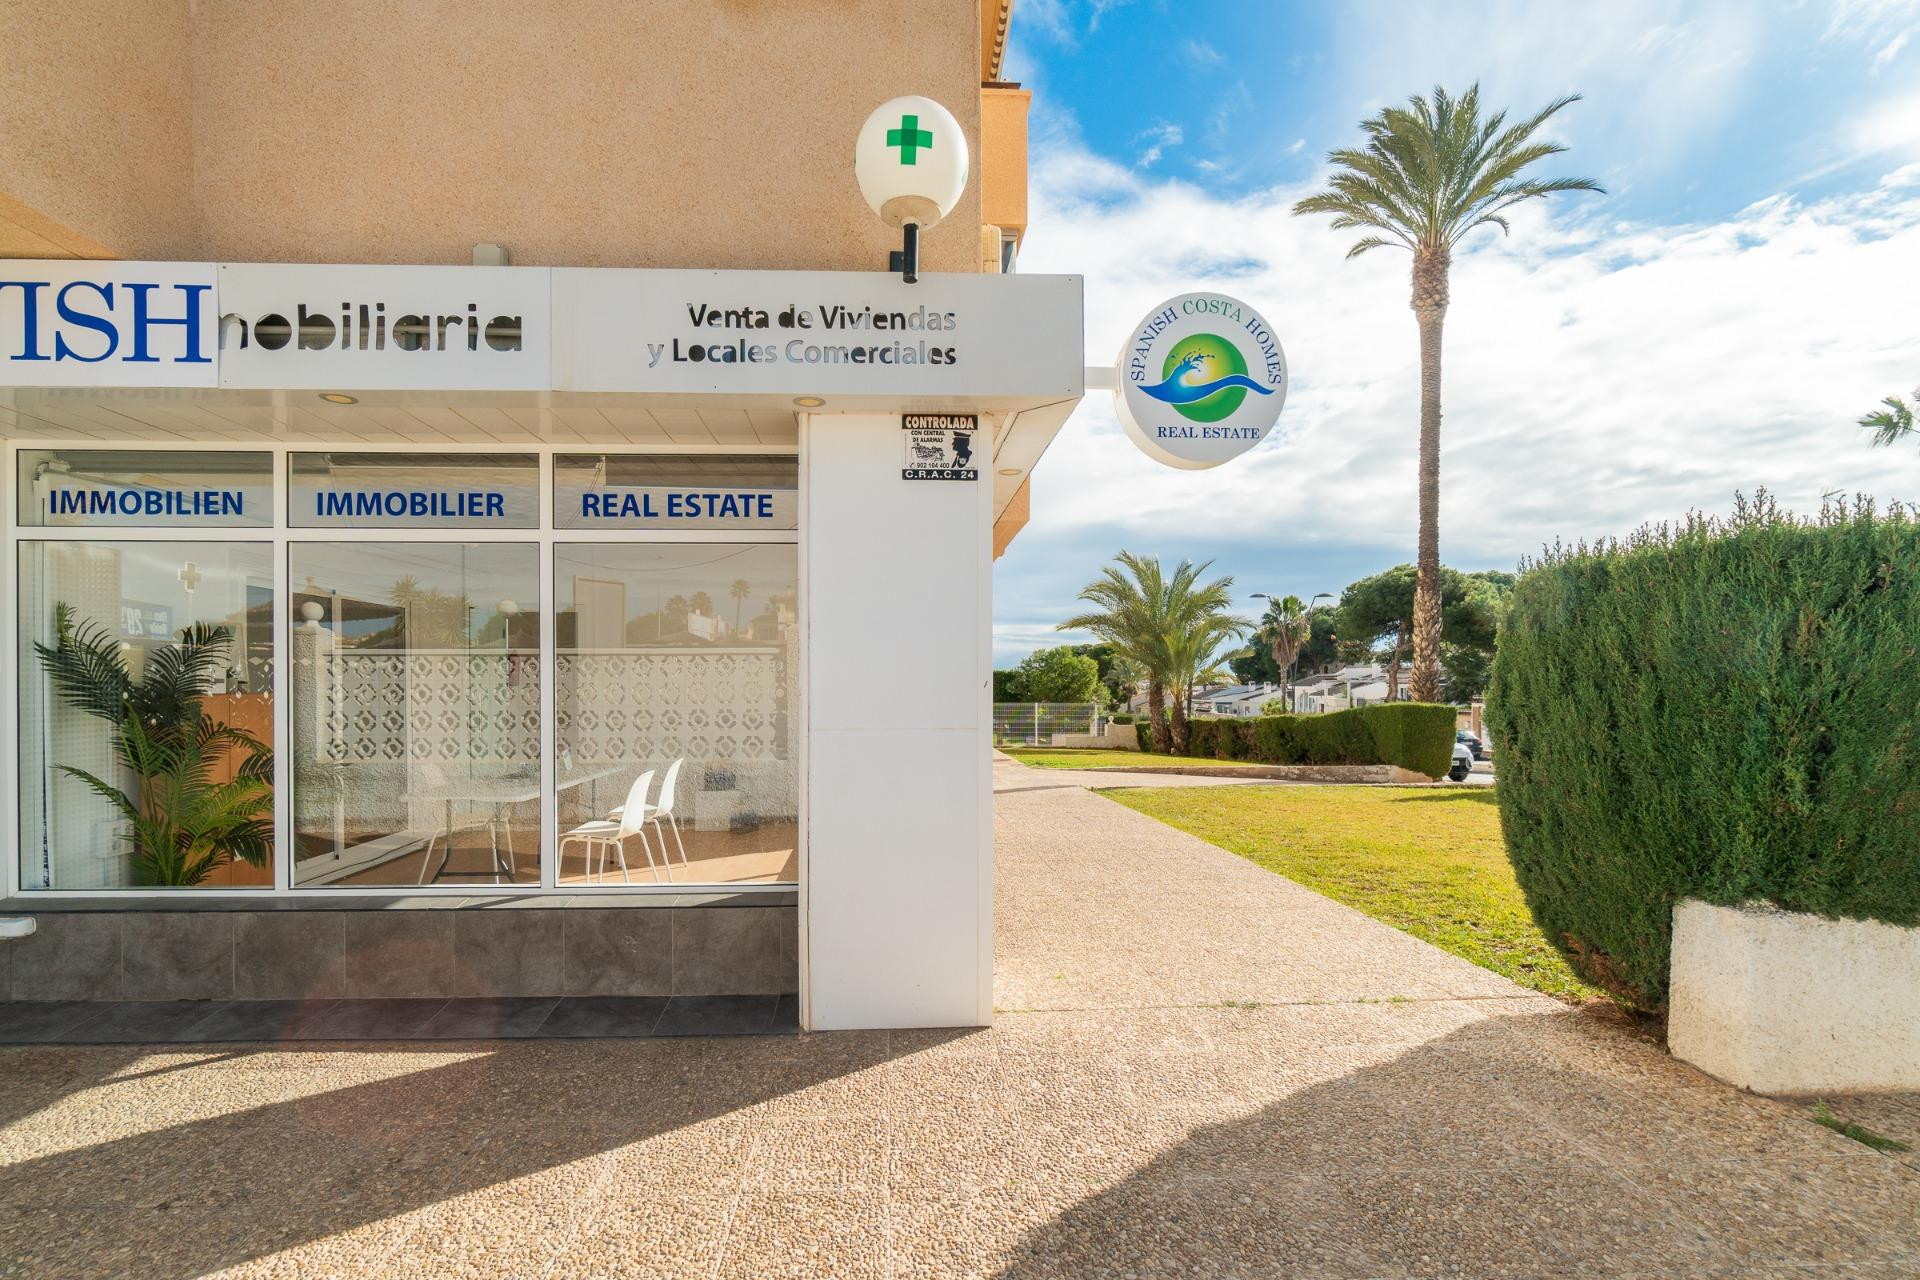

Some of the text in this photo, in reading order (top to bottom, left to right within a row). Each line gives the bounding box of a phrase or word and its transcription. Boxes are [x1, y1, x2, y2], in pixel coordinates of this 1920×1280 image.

[0, 281, 212, 362] ISH
[686, 303, 956, 331] Venta de Viviendas
[647, 338, 957, 368] y Locales Comerciales
[1131, 299, 1282, 384] SPANISH COSTA HOMES
[905, 416, 974, 429] CONTROLADA
[1156, 426, 1260, 439] REAL ESTATE
[905, 470, 975, 479] C.R.A.C. 24
[50, 490, 243, 515] IMMOBILIEN
[317, 492, 505, 517] IMMOBILIER
[582, 493, 774, 518] REAL ESTATE
